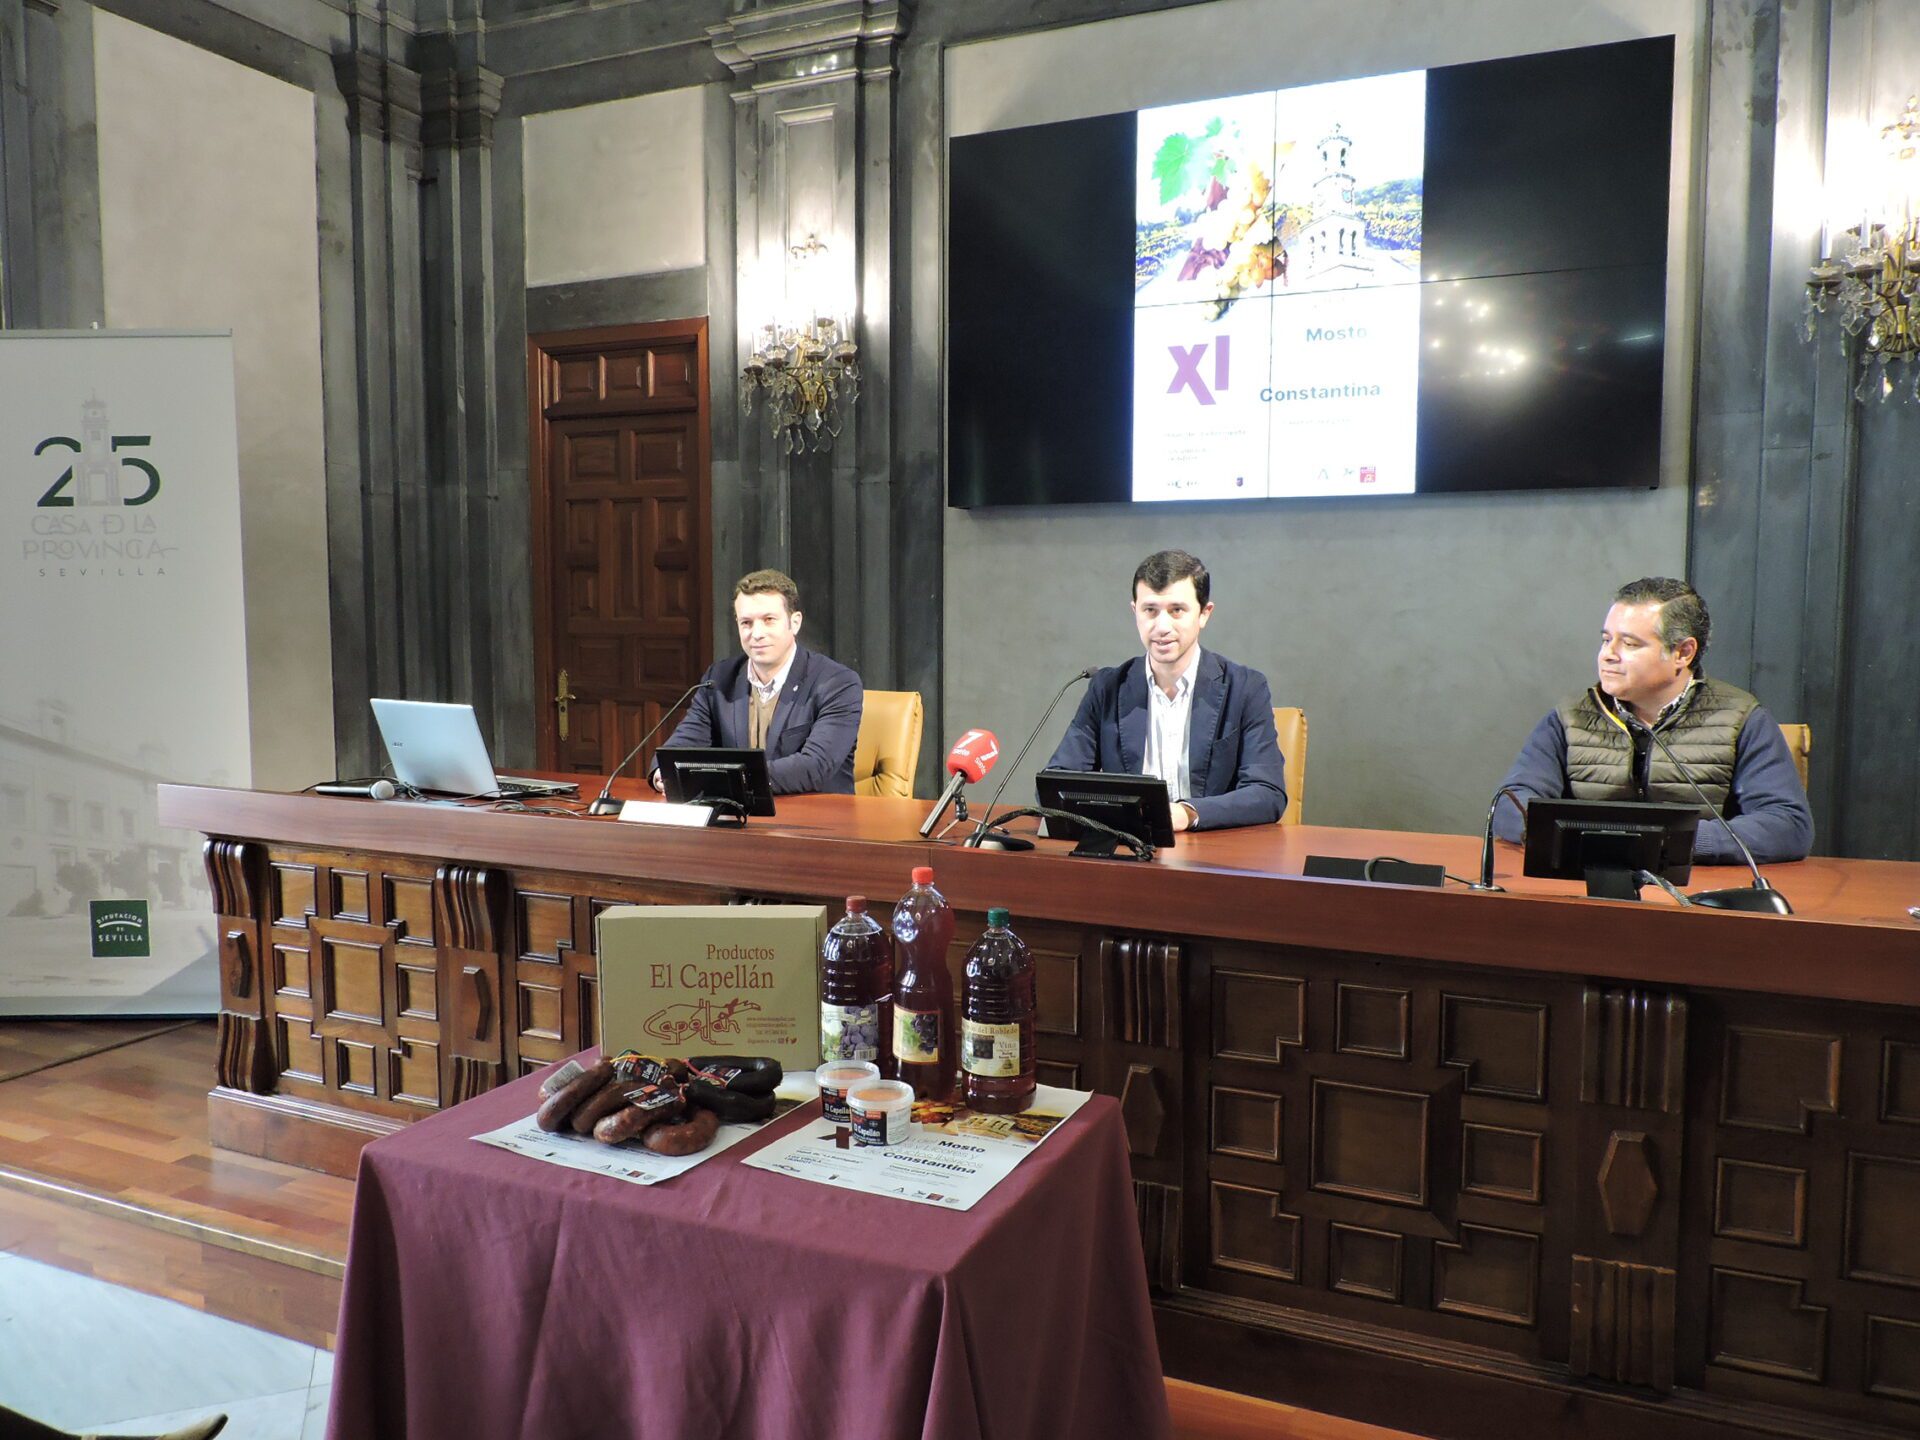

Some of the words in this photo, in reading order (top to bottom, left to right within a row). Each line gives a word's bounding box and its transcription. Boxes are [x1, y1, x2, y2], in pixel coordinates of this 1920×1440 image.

[1306, 325, 1368, 342] Mosto
[1166, 335, 1231, 406] XI
[1259, 382, 1381, 402] Constantina
[34, 435, 161, 508] 25
[30, 513, 92, 536] CASA
[133, 513, 157, 534] LA
[22, 538, 179, 561] PROVINCIA
[39, 567, 166, 578] SEVILLA
[98, 934, 143, 942] SEVILLA
[706, 943, 775, 960] Productos
[650, 962, 673, 988] El
[680, 963, 775, 995] Capellán
[938, 1140, 986, 1153] Mosto
[883, 1152, 977, 1174] Constantina
